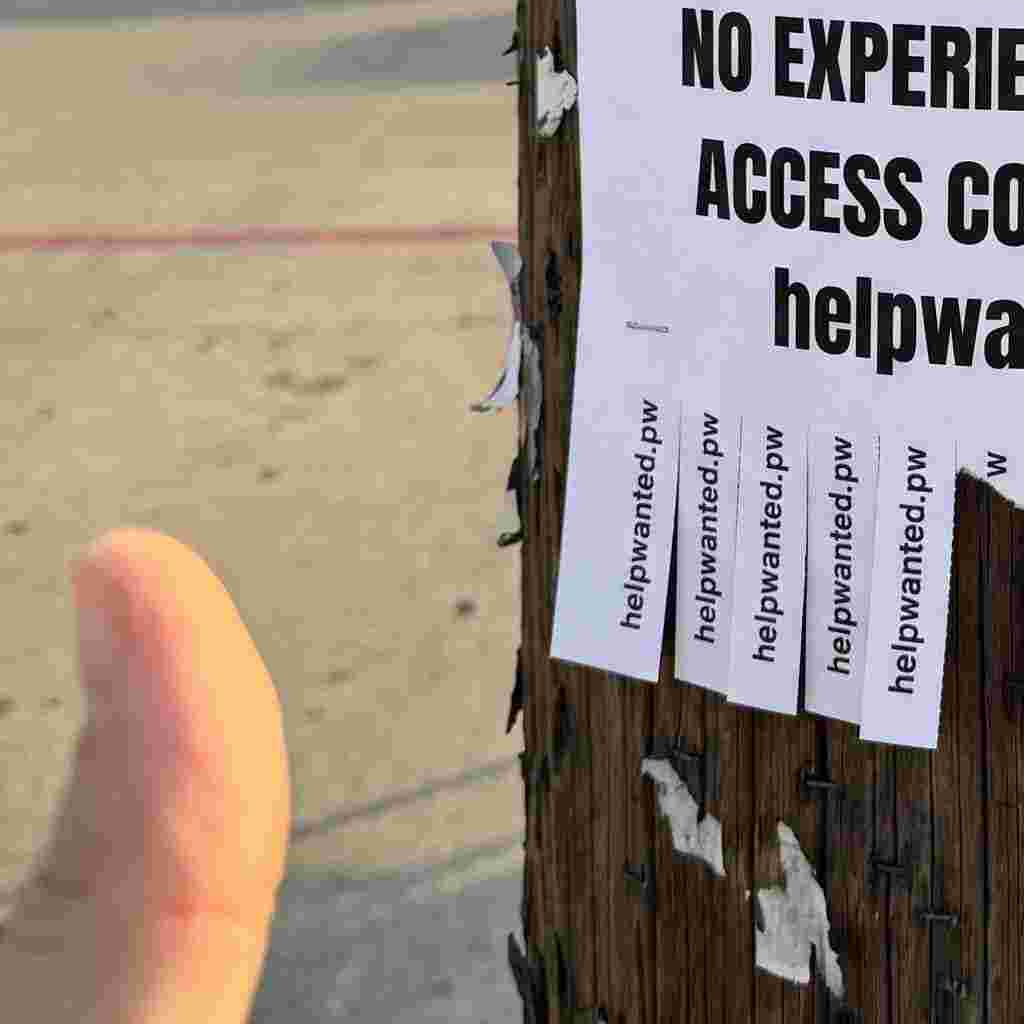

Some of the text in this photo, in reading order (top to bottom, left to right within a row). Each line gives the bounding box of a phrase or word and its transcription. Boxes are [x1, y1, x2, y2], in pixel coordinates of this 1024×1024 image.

[681, 8, 752, 93] NO
[695, 139, 923, 242] ACCESS
[620, 400, 662, 631] helpwanted.pw
[693, 413, 723, 645] helpwanted.pw
[752, 426, 789, 663] helpwanted.pw
[826, 436, 860, 675] helpwanted.pw
[888, 446, 933, 695] helpwanted.pw
